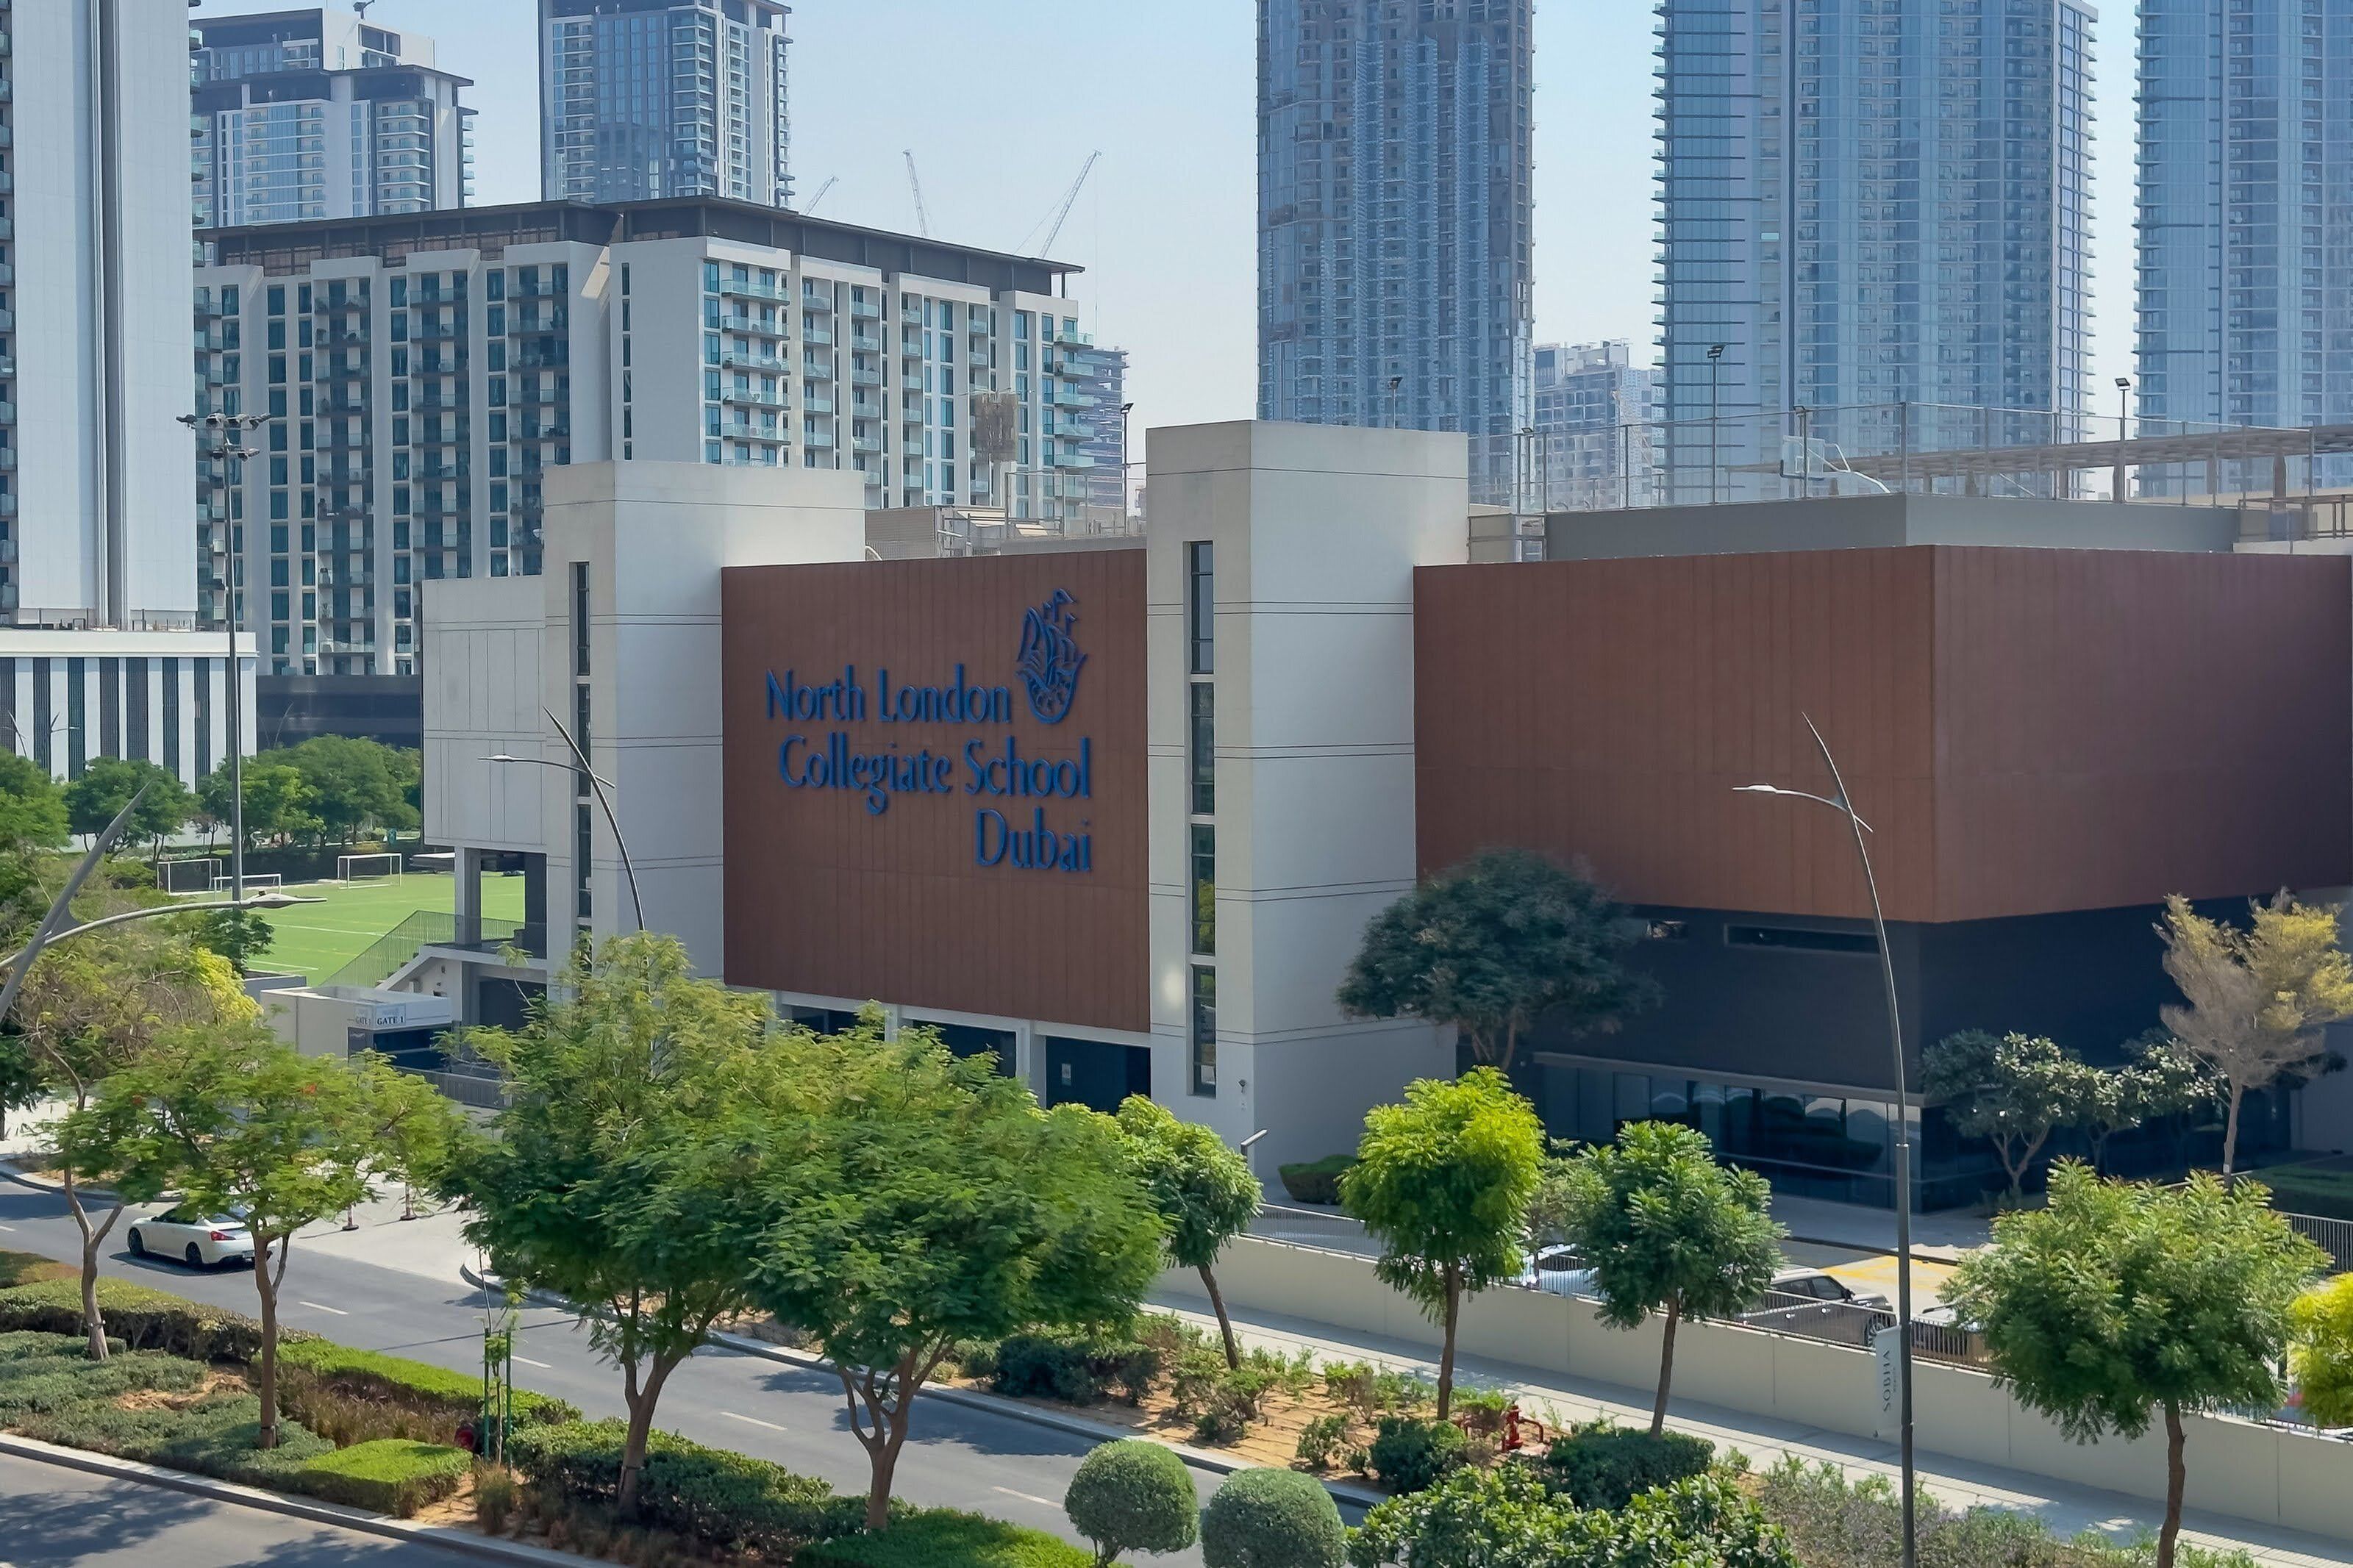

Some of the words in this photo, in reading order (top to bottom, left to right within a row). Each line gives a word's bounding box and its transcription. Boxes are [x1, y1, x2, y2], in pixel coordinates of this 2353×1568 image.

[766, 665, 864, 720] North
[878, 664, 1012, 724] London
[779, 732, 952, 815] Collegiate
[964, 736, 1090, 798] School
[976, 806, 1091, 872] Dubai
[376, 1017, 399, 1025] GATE
[400, 1015, 404, 1023] 1
